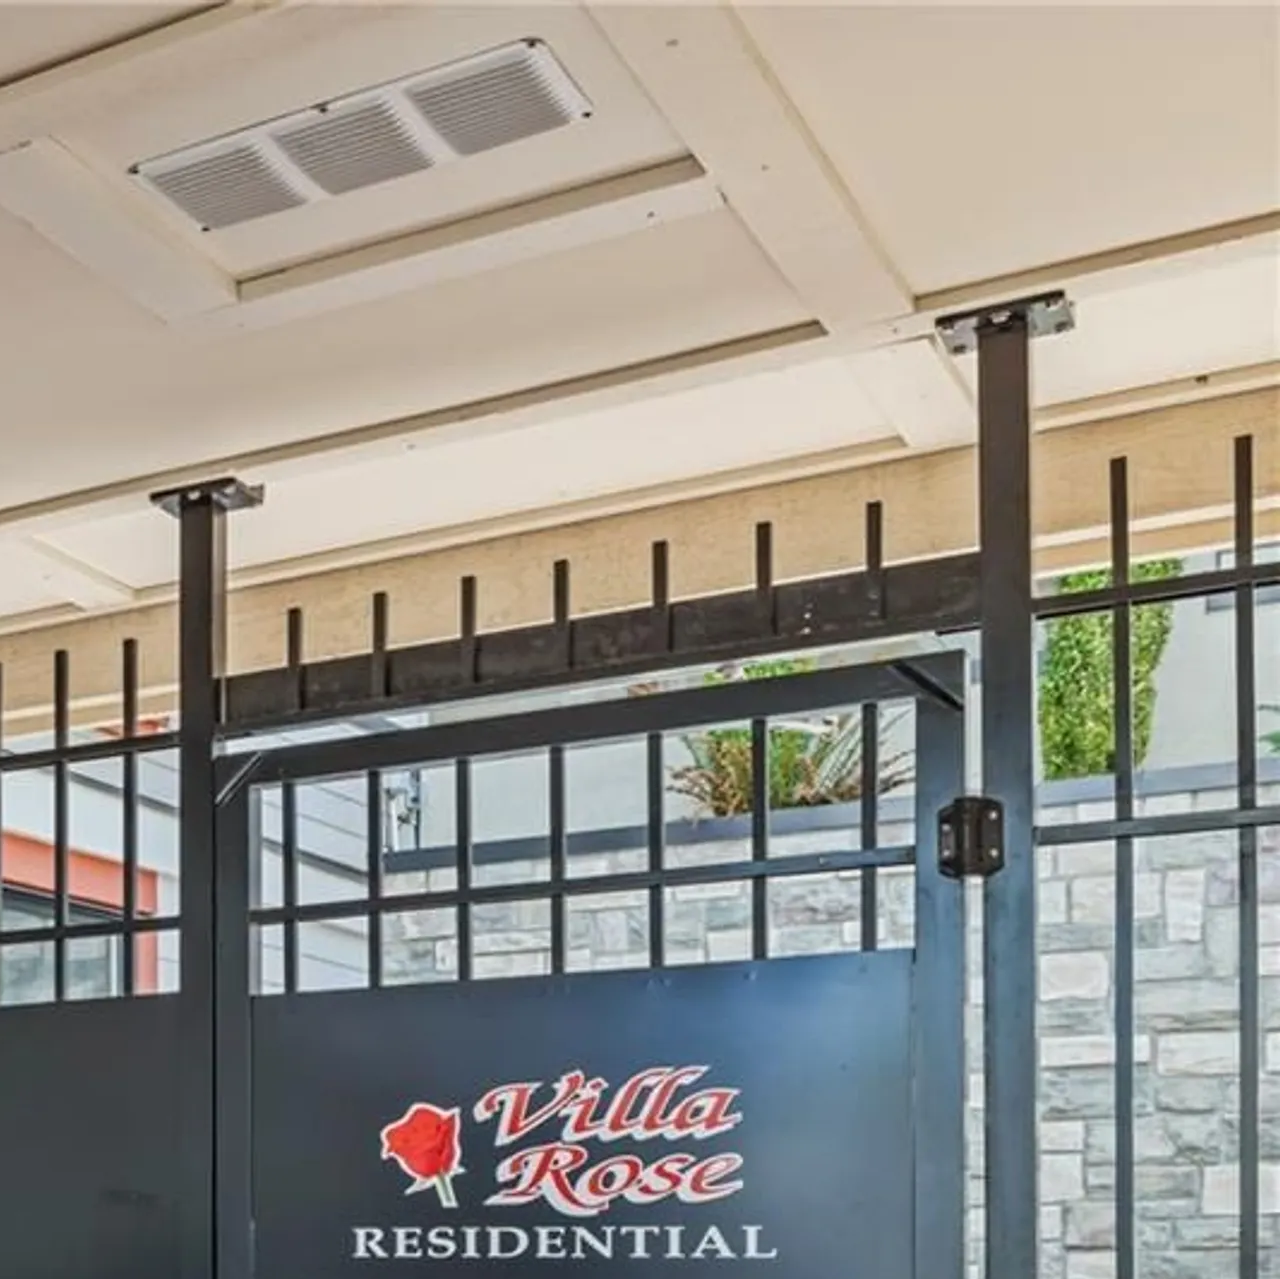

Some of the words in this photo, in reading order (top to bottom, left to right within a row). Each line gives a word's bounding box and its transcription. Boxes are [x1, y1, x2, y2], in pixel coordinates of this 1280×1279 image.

[473, 1065, 743, 1146] Villa
[483, 1142, 744, 1217] Rose
[352, 1225, 778, 1260] RESIDENTIAL
